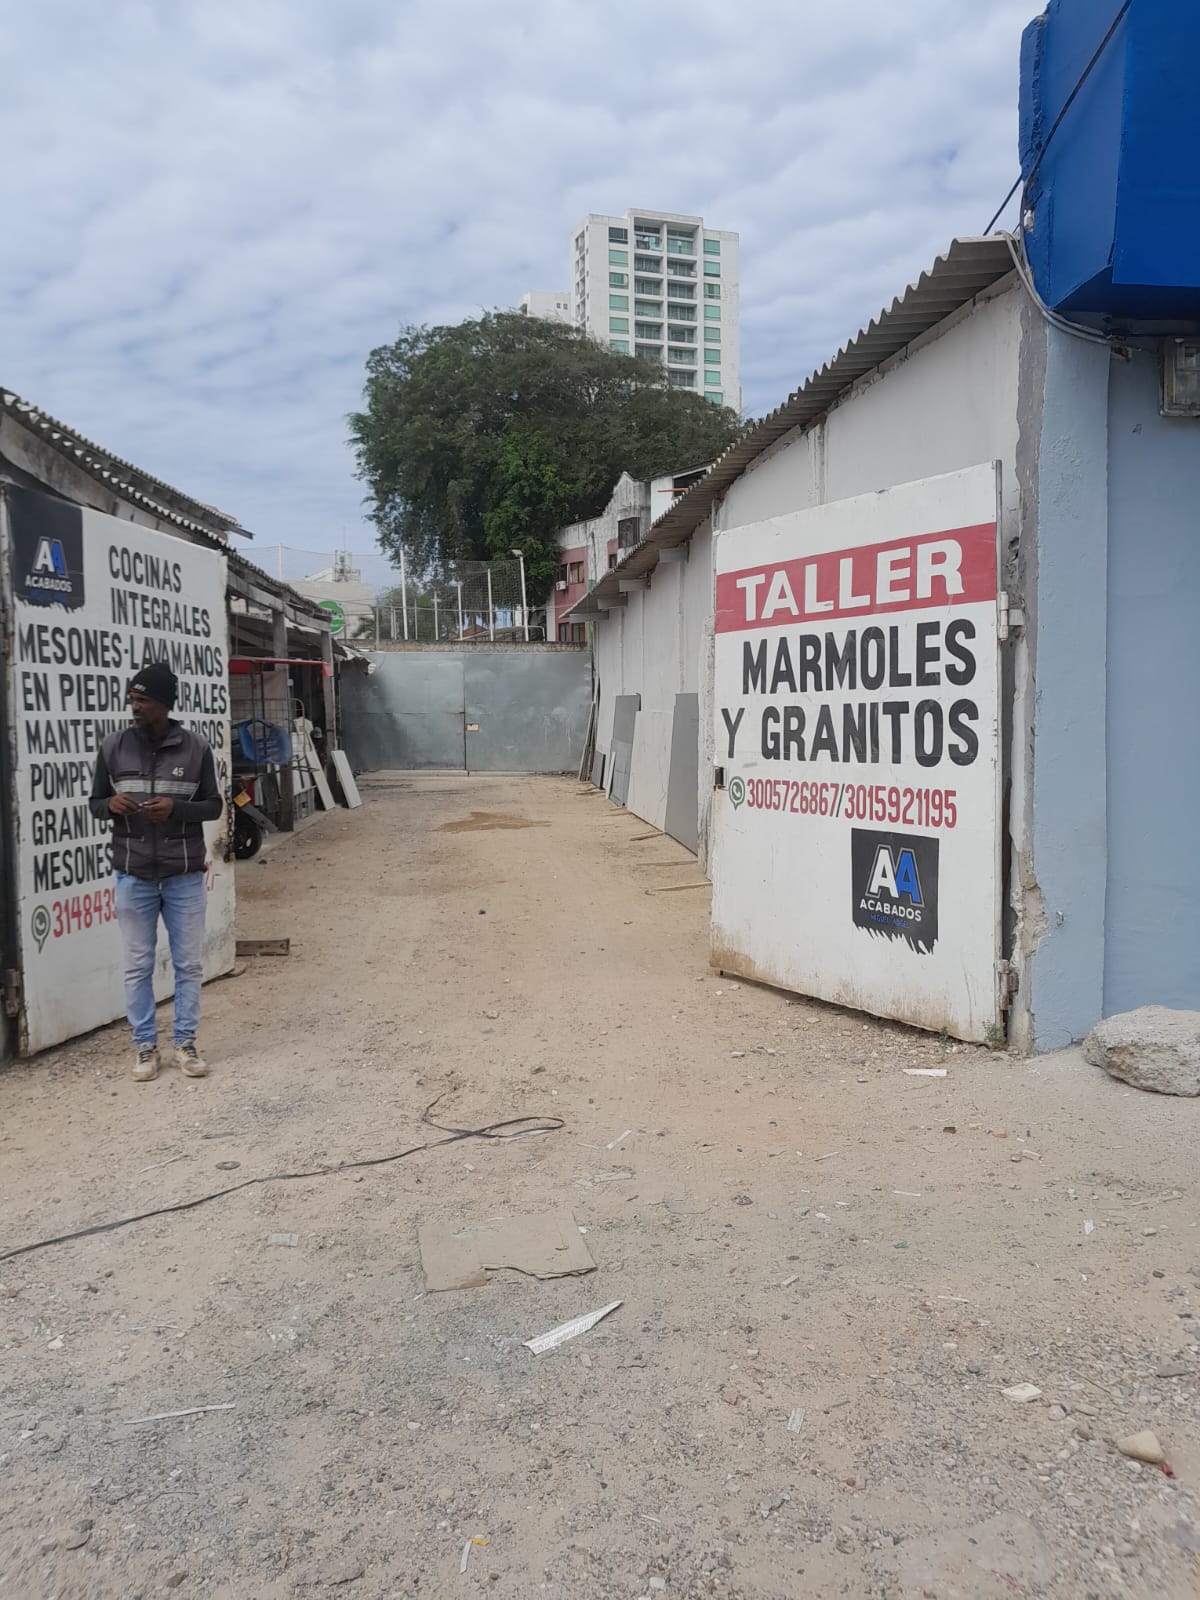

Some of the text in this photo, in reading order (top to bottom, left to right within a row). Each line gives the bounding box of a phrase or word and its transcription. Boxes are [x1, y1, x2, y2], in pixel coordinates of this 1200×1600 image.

[25, 574, 72, 592] ACABADOS
[108, 545, 182, 594] COCINAS
[736, 539, 965, 621] TALLER
[110, 587, 211, 638] INTEGRALES
[742, 618, 977, 695] MARMOLES
[22, 671, 50, 712] EN
[177, 681, 227, 714] URALES
[721, 698, 979, 767] Y GRANITOS
[171, 766, 184, 777] 45
[747, 778, 957, 828] 3005726867/3015921195
[33, 842, 114, 894] MESONES
[866, 845, 924, 907] AA
[52, 887, 116, 938] 314843
[860, 898, 922, 922] ACABADOS
